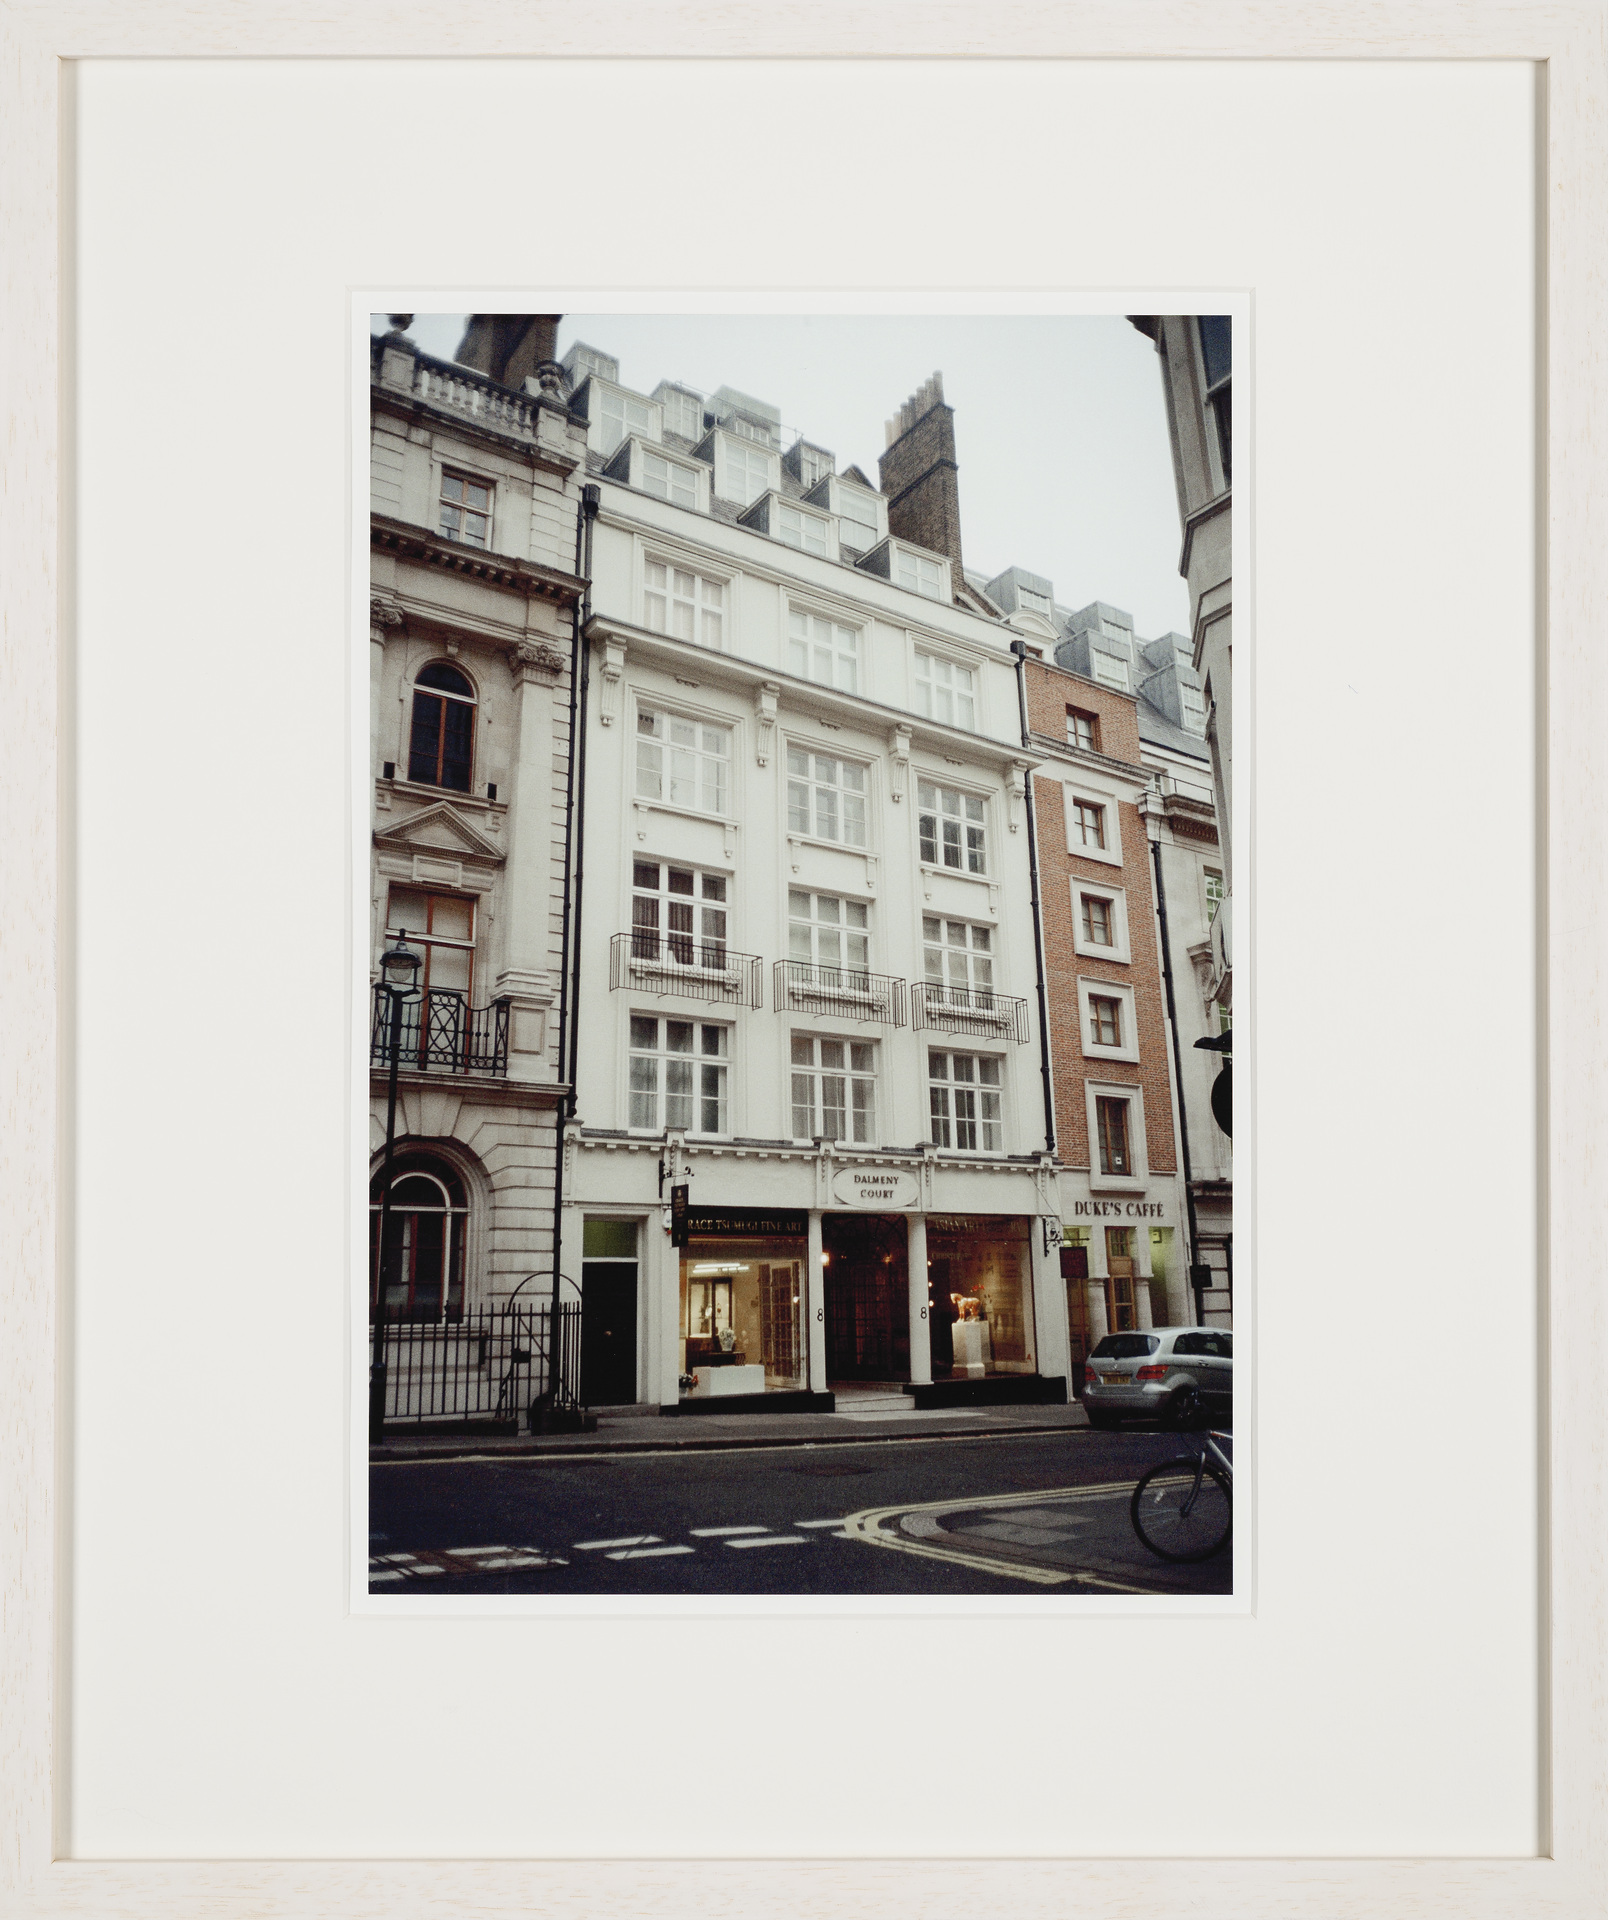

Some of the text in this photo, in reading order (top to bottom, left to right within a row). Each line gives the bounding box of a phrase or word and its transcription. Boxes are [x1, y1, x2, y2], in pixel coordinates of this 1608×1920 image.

[853, 1174, 899, 1185] DALMENY
[860, 1189, 894, 1199] COURT
[1075, 1200, 1164, 1218] DUKE'S CAFFÉ
[687, 1219, 713, 1230] RACE
[761, 1221, 781, 1231] FINE
[785, 1221, 803, 1232] ART
[817, 1307, 824, 1322] 8
[920, 1306, 928, 1319] 8
